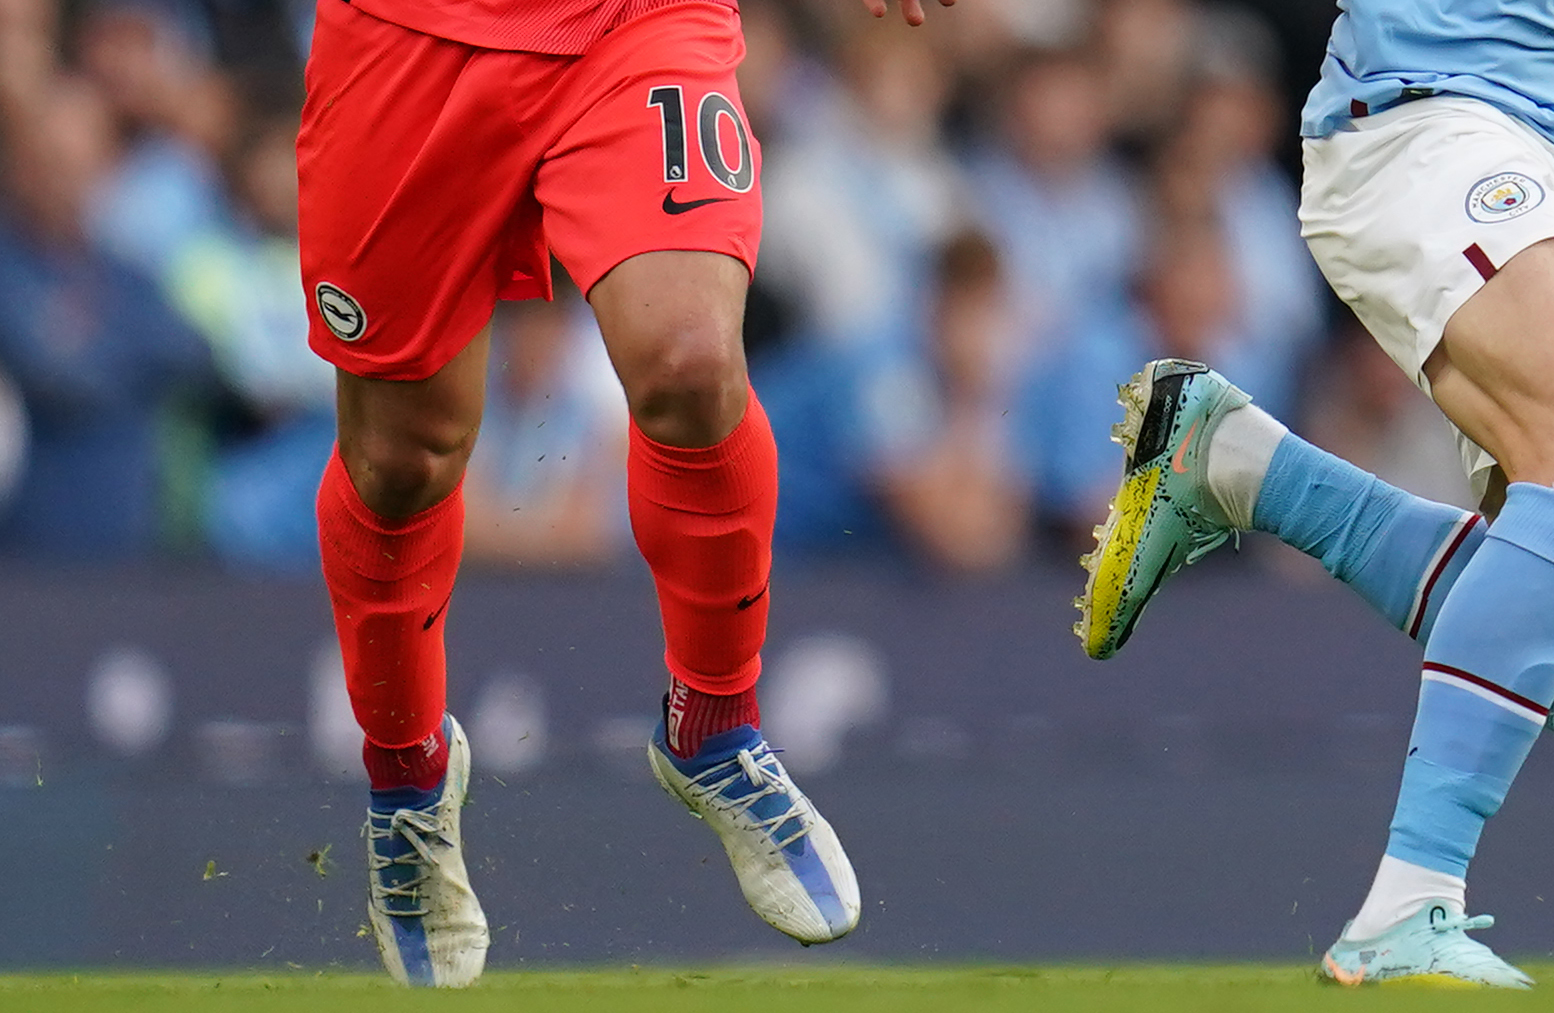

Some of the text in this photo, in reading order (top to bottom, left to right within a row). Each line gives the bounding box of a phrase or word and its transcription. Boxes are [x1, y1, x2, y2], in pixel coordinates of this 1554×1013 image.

[646, 84, 755, 193] 10
[1472, 175, 1526, 209] MANCHESTER
[1508, 204, 1530, 218] CITY
